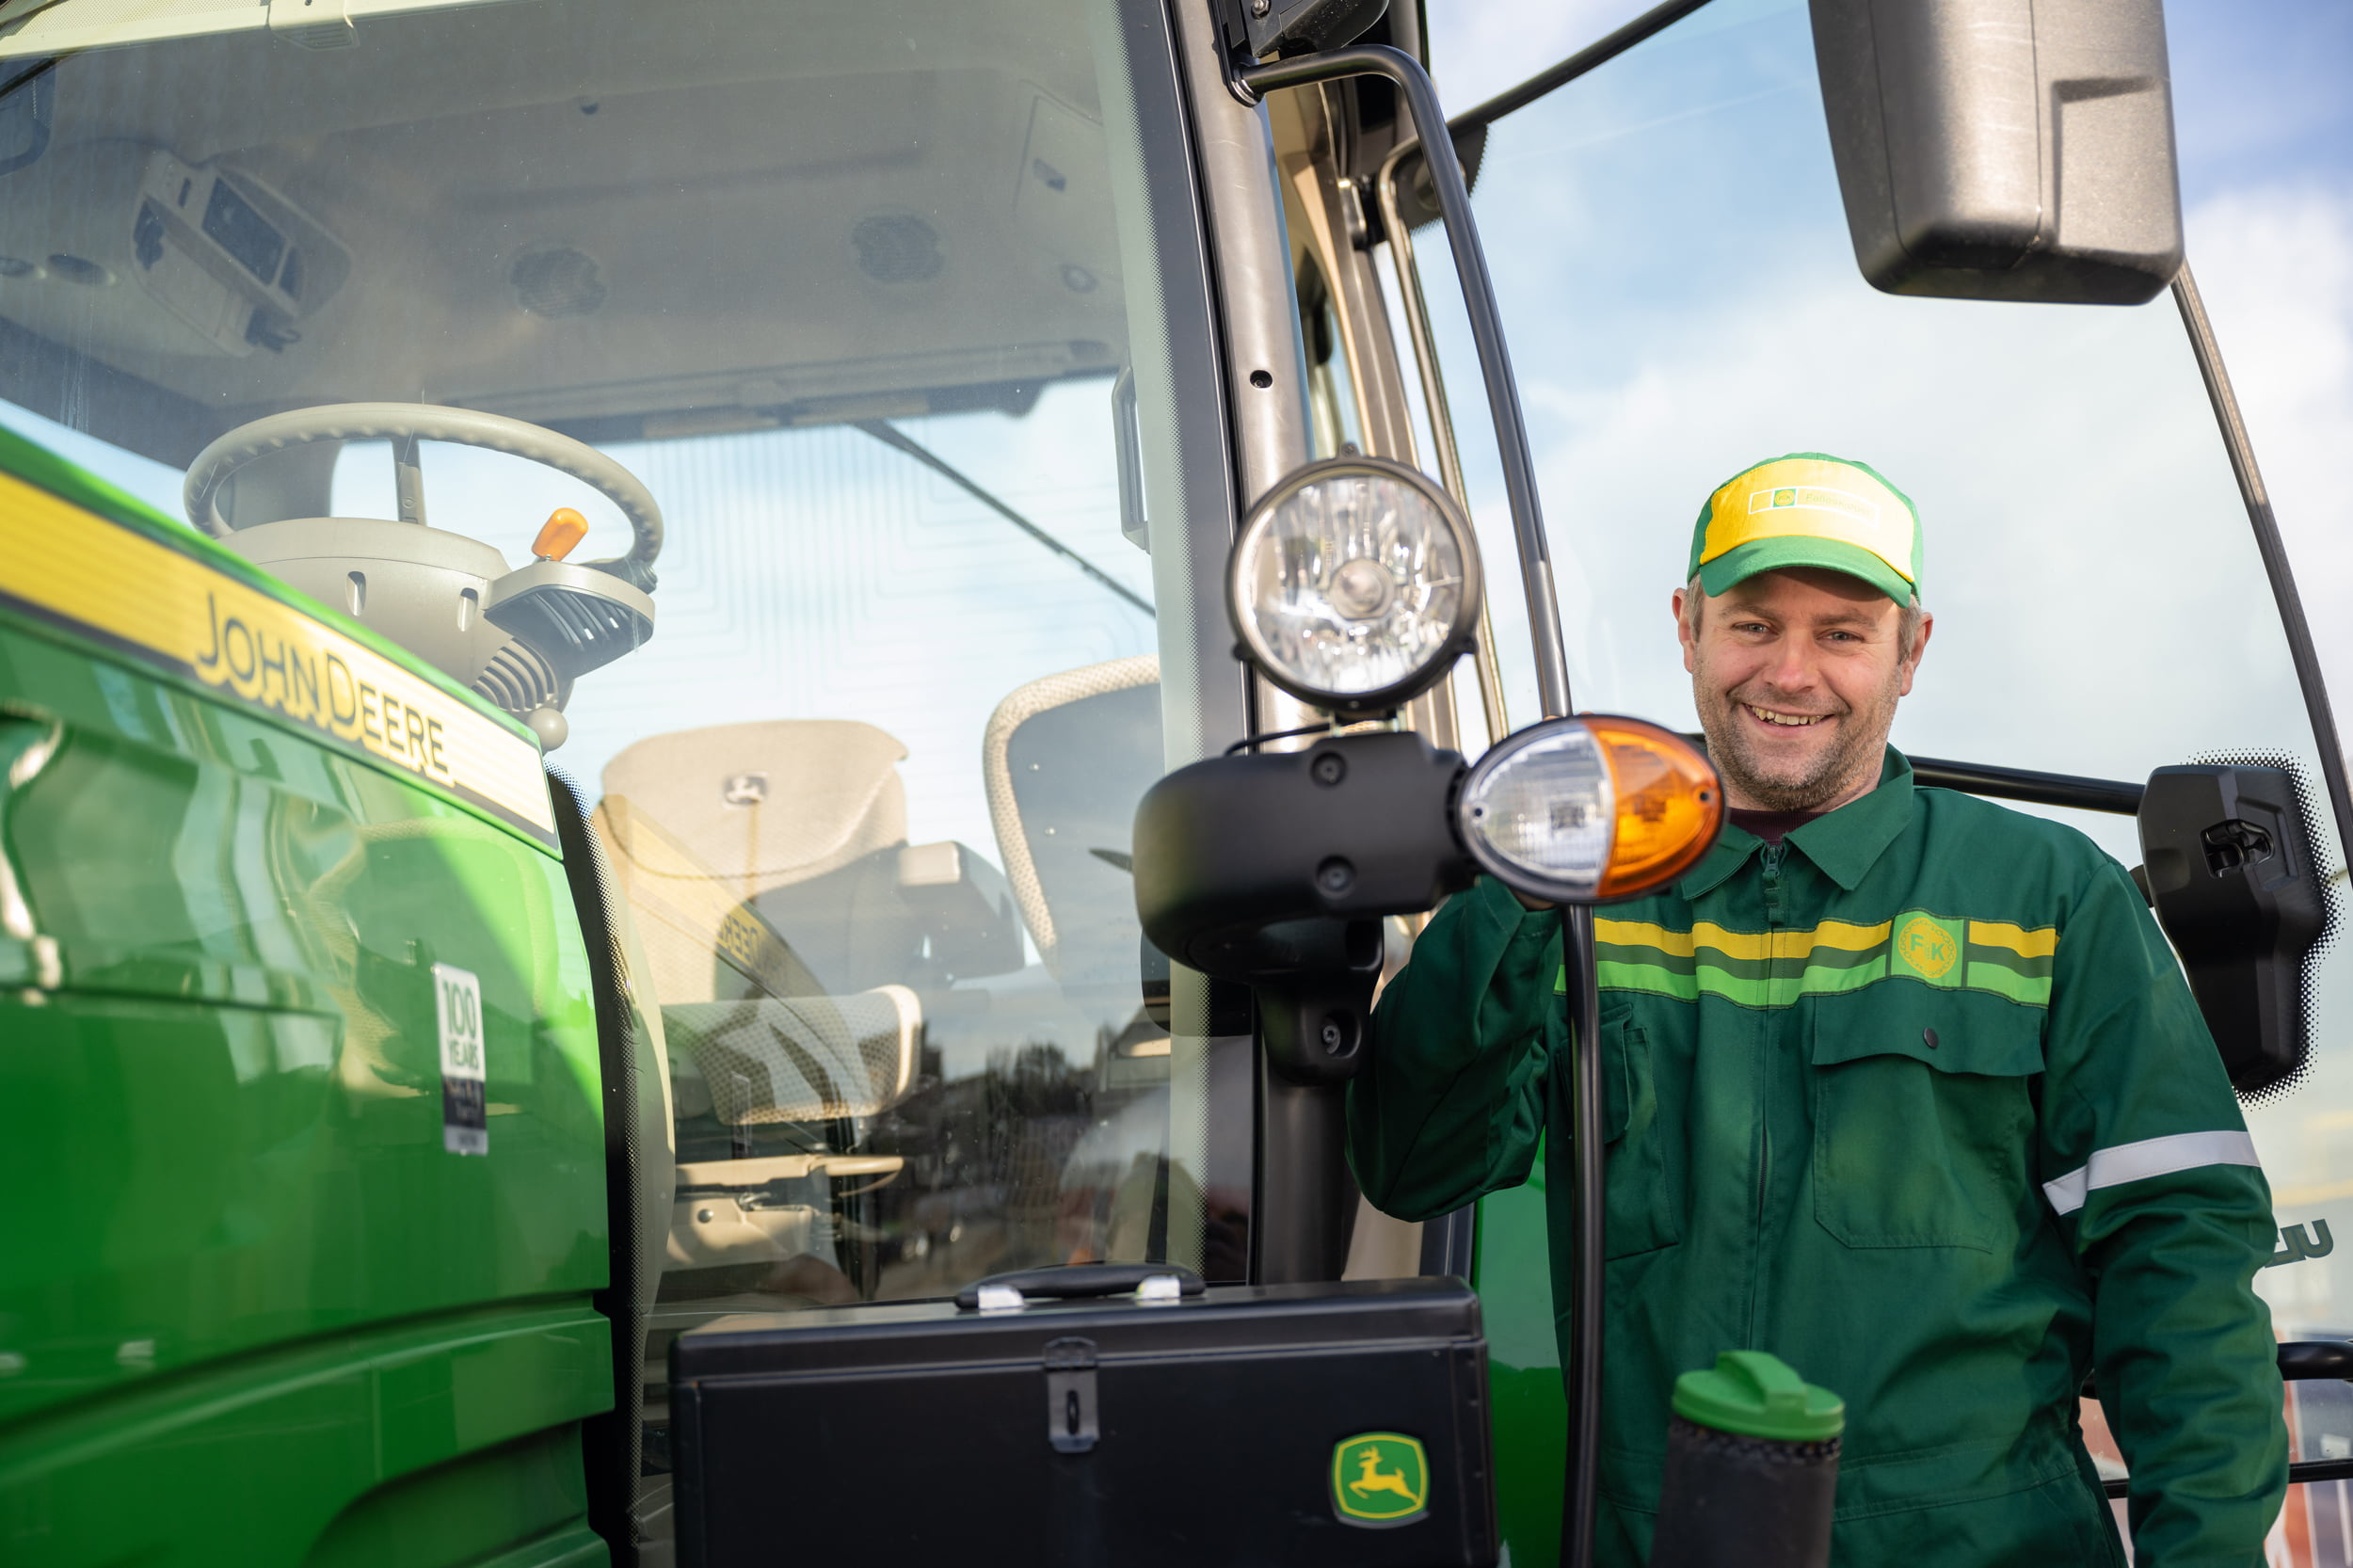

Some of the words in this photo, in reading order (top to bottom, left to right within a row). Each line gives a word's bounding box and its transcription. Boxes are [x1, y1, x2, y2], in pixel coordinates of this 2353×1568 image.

[198, 591, 321, 712] JOHN
[326, 649, 448, 774] DEERE
[442, 979, 476, 1039] 100
[447, 1038, 479, 1071] YEARS
